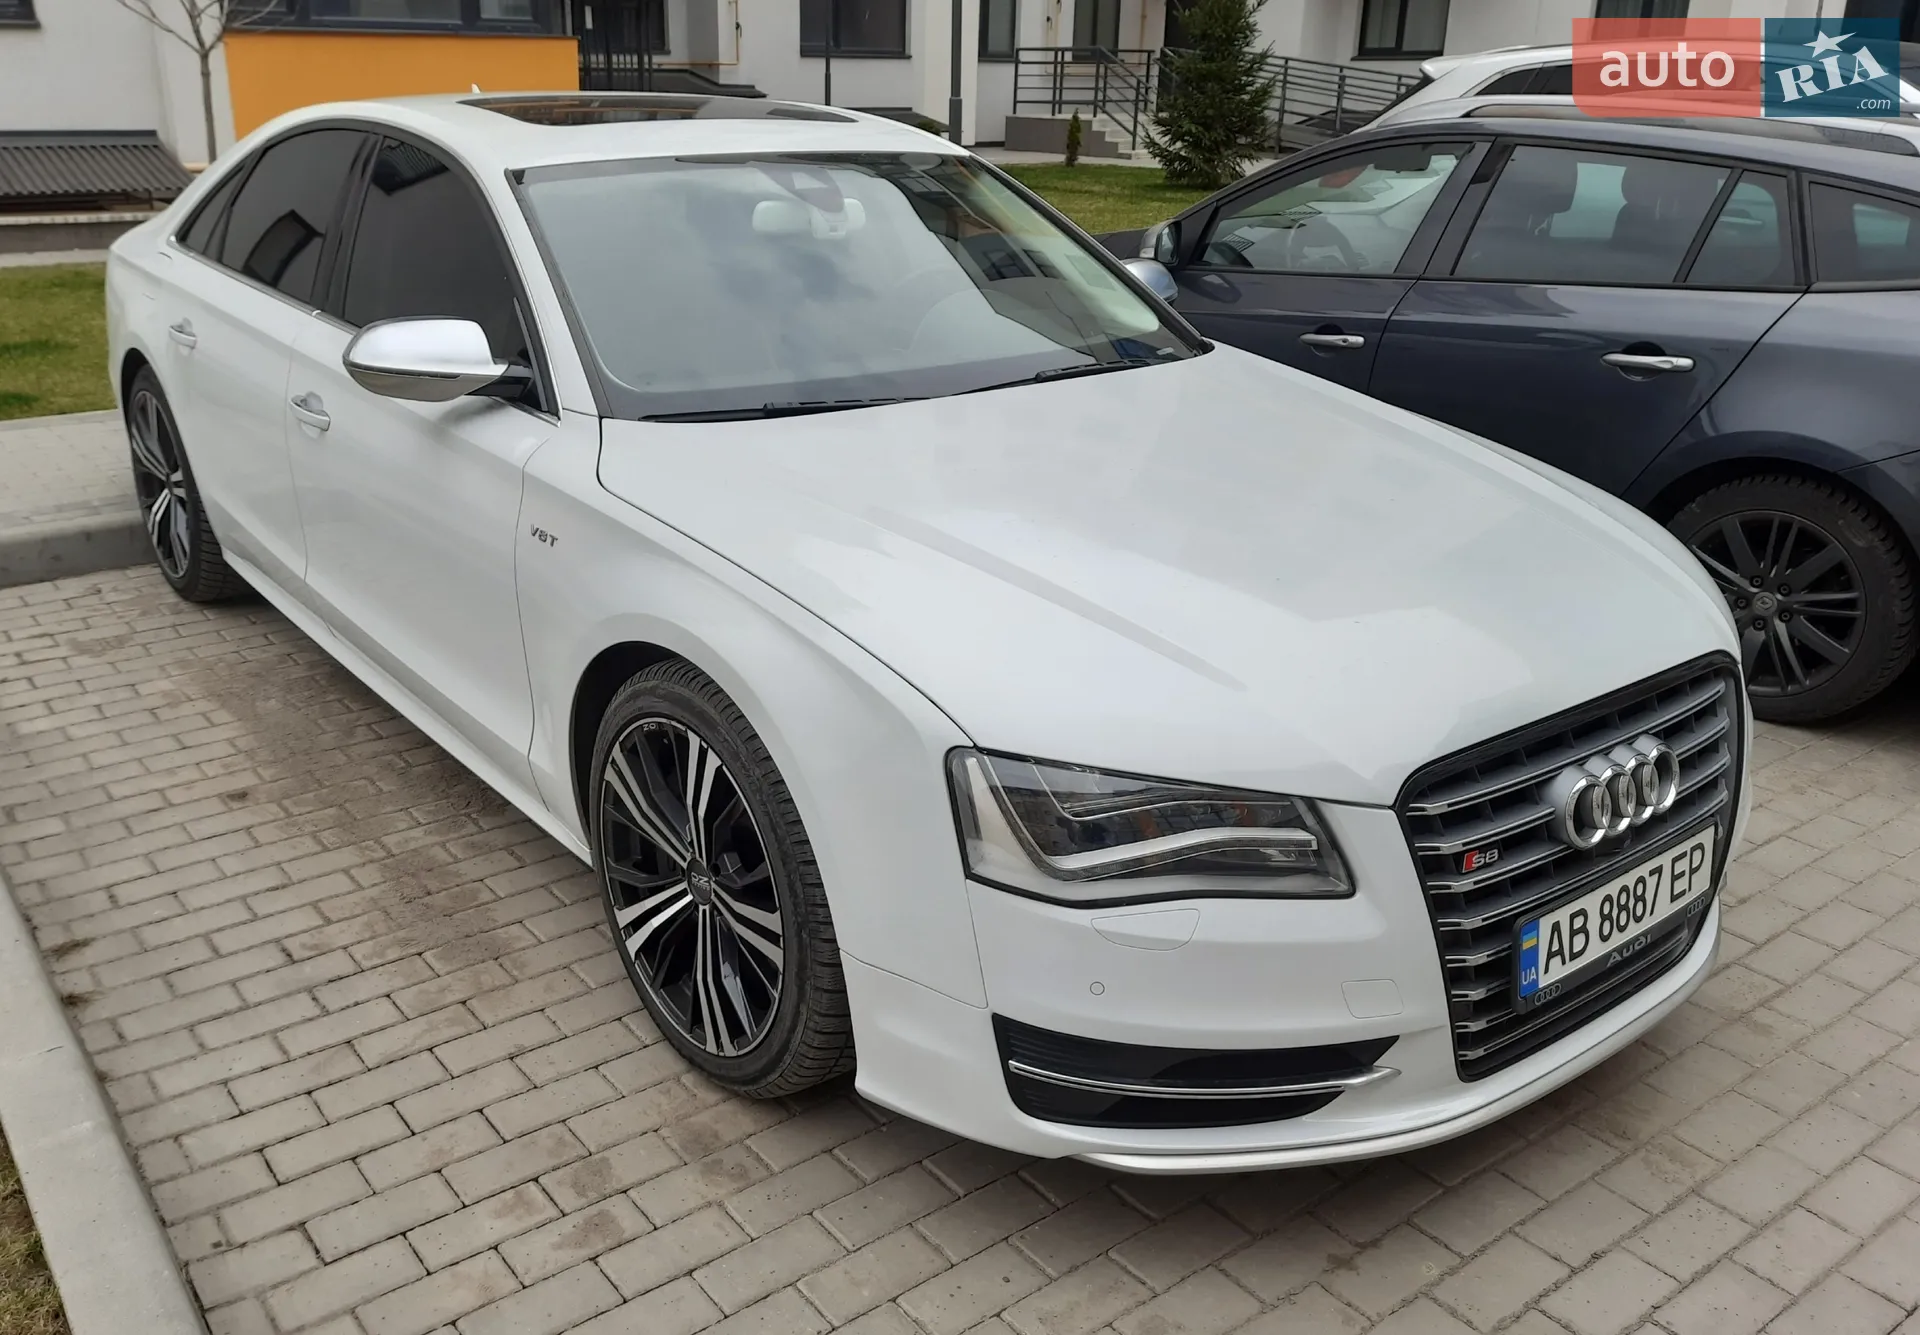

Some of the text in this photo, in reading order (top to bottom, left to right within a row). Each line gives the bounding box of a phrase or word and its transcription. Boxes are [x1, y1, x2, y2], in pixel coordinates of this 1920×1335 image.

[530, 523, 559, 547] V8T
[1544, 842, 1706, 975] AB 8887 EP
[1522, 966, 1537, 985] UA
